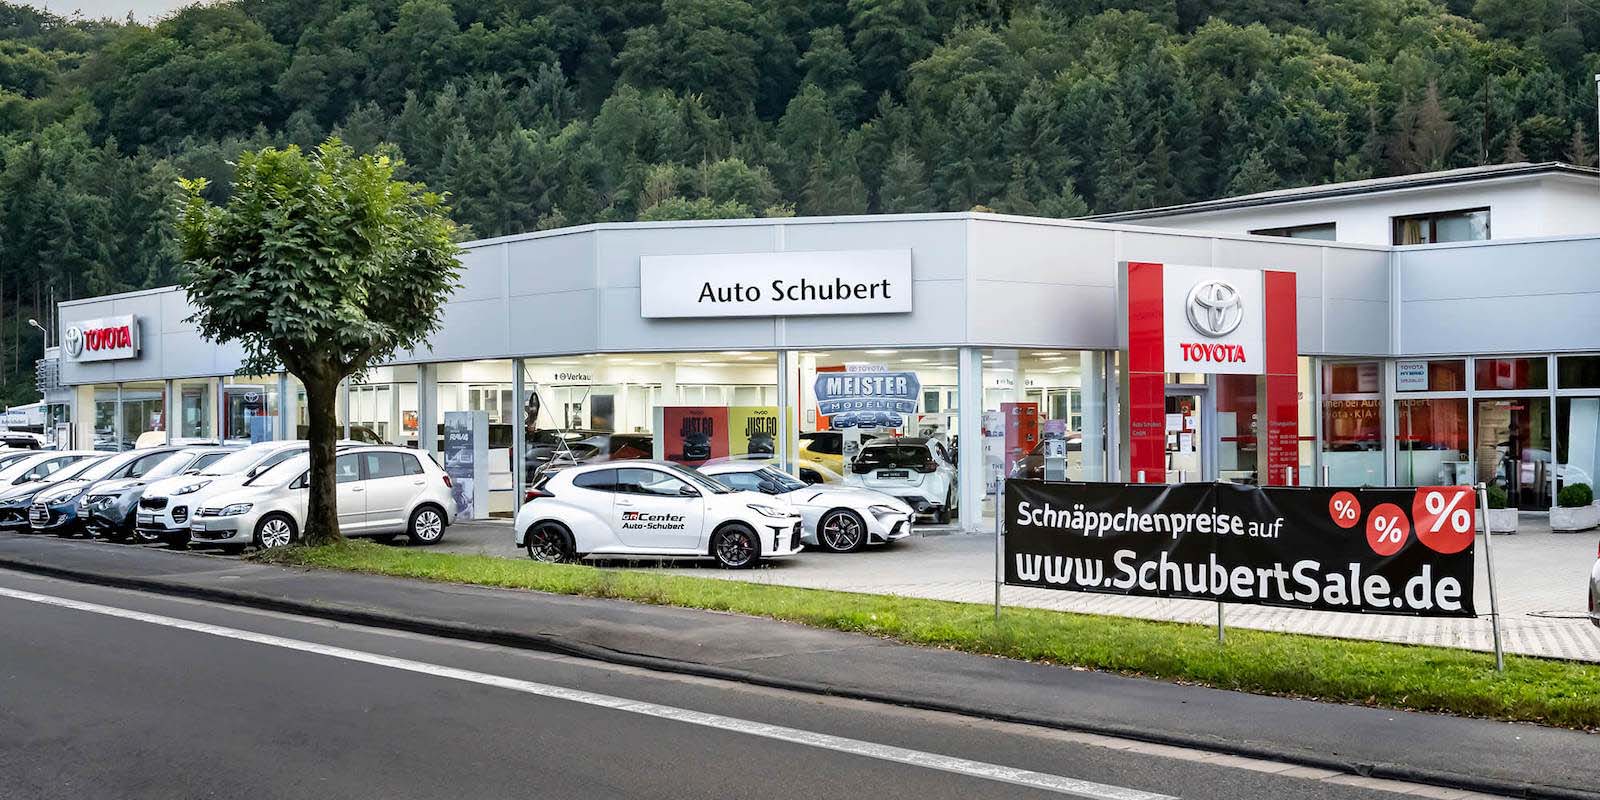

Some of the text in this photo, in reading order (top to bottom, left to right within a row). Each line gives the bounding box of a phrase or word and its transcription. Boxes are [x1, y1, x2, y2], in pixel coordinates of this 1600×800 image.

[698, 277, 891, 303] Auto Schubert
[83, 325, 132, 351] TOYOTA
[1180, 343, 1246, 363] TOYOTA
[827, 376, 908, 396] MEISTER
[831, 401, 903, 410] MODELLE
[1354, 409, 1373, 418] KIA
[681, 417, 713, 437] JUST GO
[745, 416, 777, 437] JUST GO
[639, 513, 686, 521] Center
[1017, 501, 1285, 539] Schnäppchenpreise auf
[1015, 549, 1463, 611] www.SchubertSale.de
